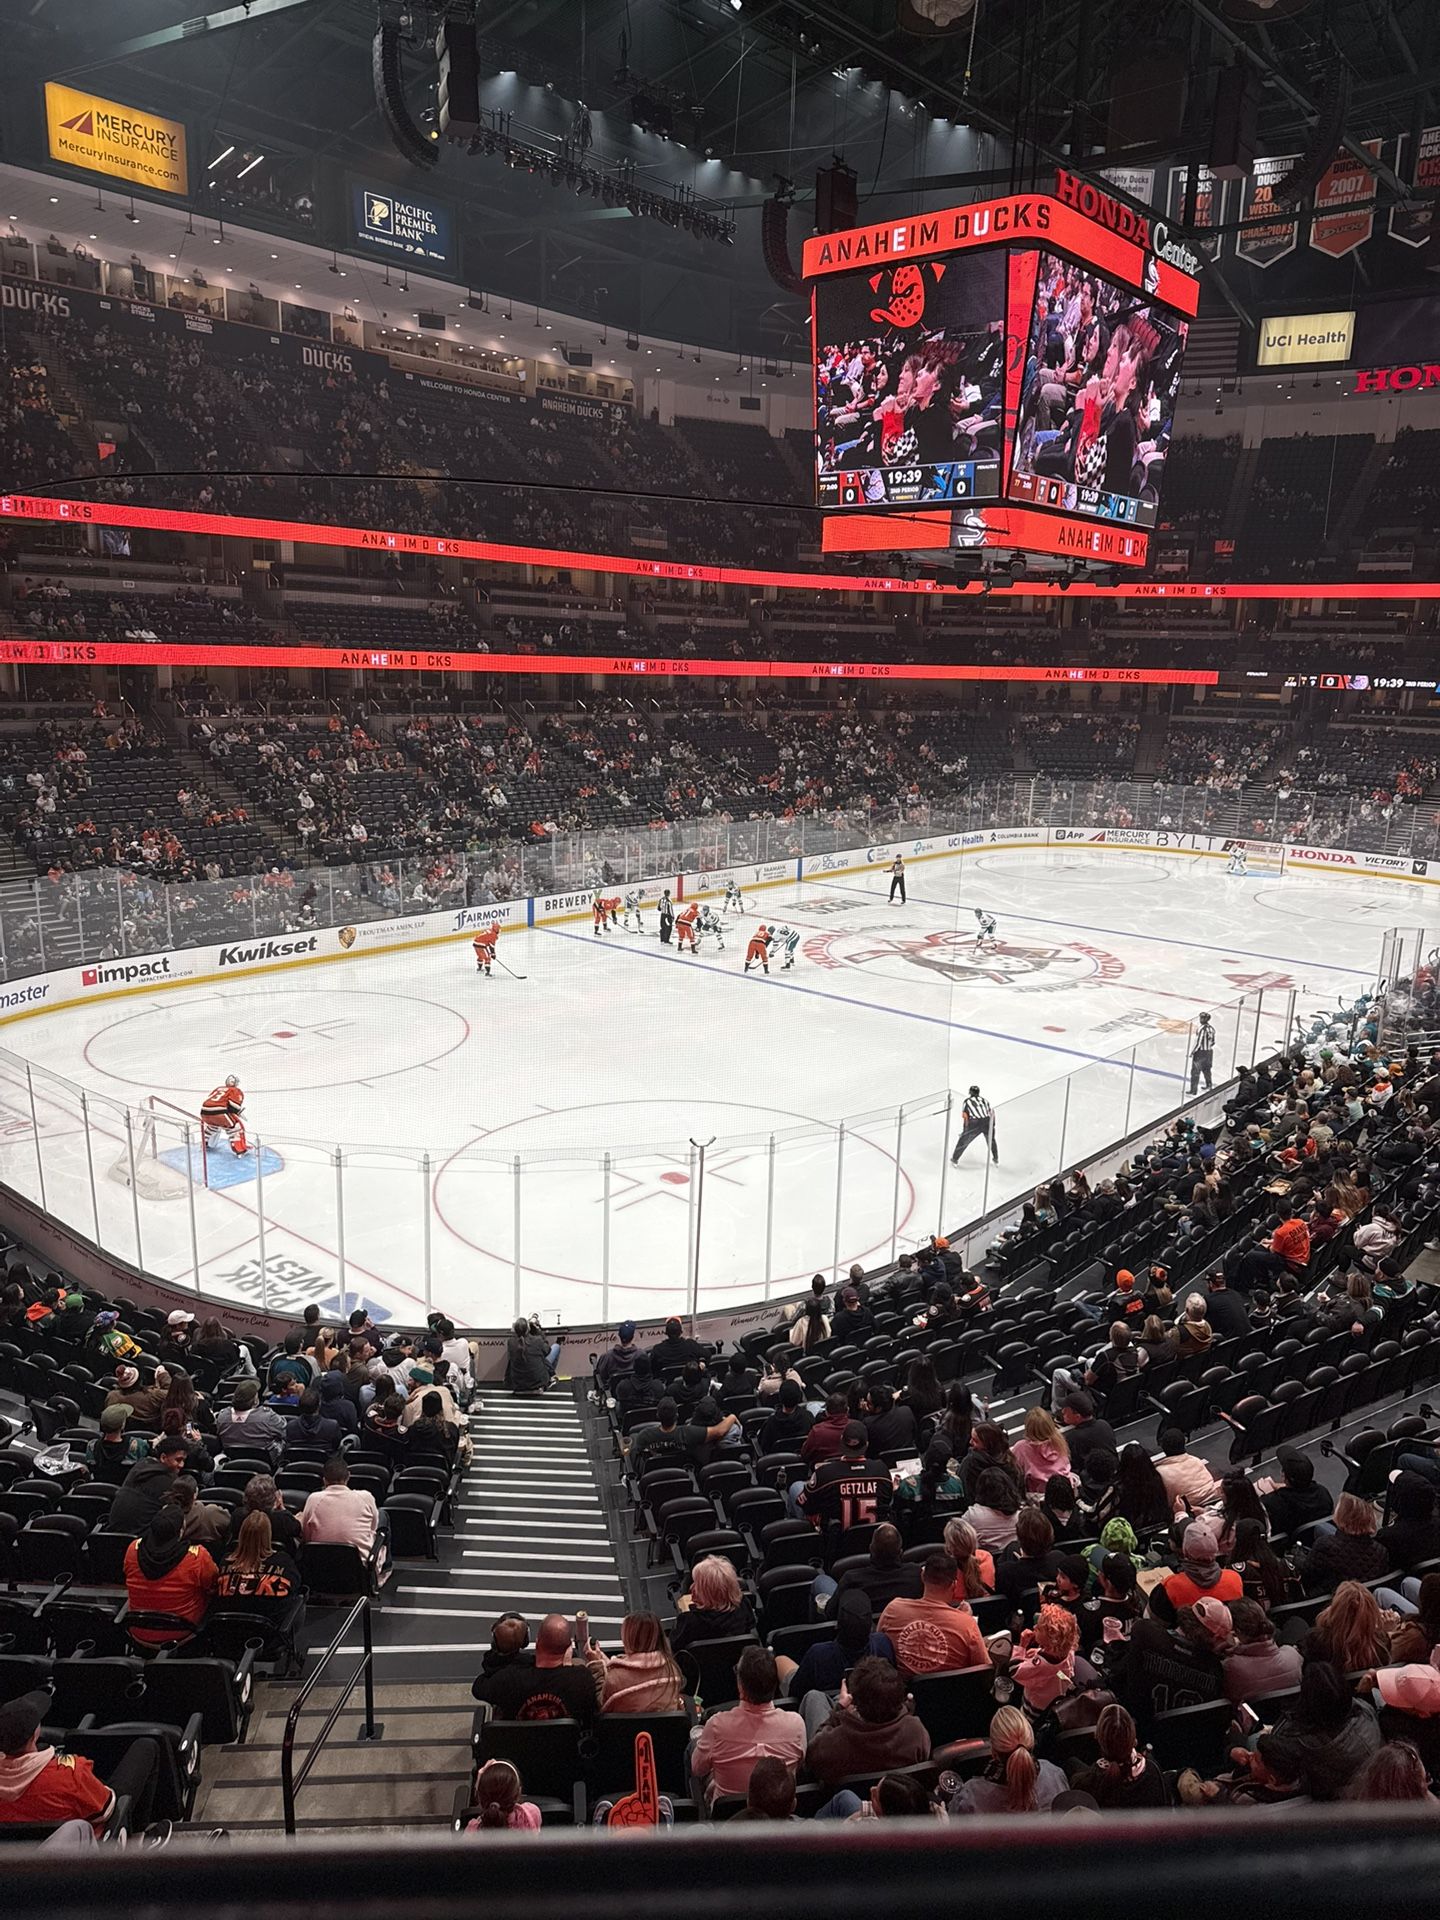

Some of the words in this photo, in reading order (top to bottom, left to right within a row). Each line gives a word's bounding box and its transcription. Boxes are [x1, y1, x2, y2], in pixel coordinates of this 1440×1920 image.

[96, 111, 176, 148] MERCURY
[96, 127, 178, 161] INSURANCE
[58, 137, 179, 181] MercuryInsurance.com
[1253, 159, 1294, 175] ANAHEIM
[1128, 174, 1149, 185] Ducks
[1329, 176, 1364, 195] 2007
[1318, 193, 1352, 208] STANLEY
[1353, 190, 1373, 202] CUP
[394, 201, 433, 222] PACIFIC
[394, 213, 438, 235] PREMIER
[1057, 168, 1151, 250] HONDA
[1153, 222, 1203, 275] Center
[394, 225, 423, 242] BANK
[819, 219, 939, 266] ANAHEIM
[953, 203, 1050, 240] DUCKS
[1241, 223, 1293, 239] CHAMPIONS
[1, 285, 70, 317] DUCKS
[1265, 335, 1292, 347] UCI
[1297, 331, 1347, 346] Health
[302, 346, 352, 373] DUCKS
[420, 379, 452, 392] WELCOME
[463, 388, 485, 399] HONDA
[486, 393, 511, 404] CENTER
[542, 398, 576, 414] ANAHEIM
[577, 404, 603, 419] DUCKS
[888, 470, 922, 485] 19:39
[845, 489, 855, 501] 0
[956, 481, 966, 494] 0
[1050, 486, 1057, 500] 0
[1080, 489, 1099, 503] 19:39
[1119, 501, 1126, 514] 0
[362, 533, 417, 549] ANAHIM
[423, 540, 459, 553] DCKS
[1058, 526, 1114, 553] ANAHEIM
[1118, 537, 1147, 559] DUCK
[636, 563, 674, 575] ANAHIM
[678, 566, 703, 577] DCKS
[1135, 586, 1185, 595] ANAHIM
[1190, 586, 1227, 595] DCKS
[341, 652, 404, 666] ANAHEIM
[411, 655, 452, 667] DCKS
[613, 660, 656, 672] ANAHEIM
[660, 662, 689, 673] DCKS
[812, 664, 855, 675] ANAHEIM
[859, 665, 890, 676] DCKS
[1045, 669, 1098, 679] ANAHEIM
[1103, 670, 1141, 680] DCKS
[1326, 677, 1335, 686] 0
[1373, 678, 1404, 688] 19:39
[948, 838, 961, 847] UCI
[961, 835, 984, 846] Health
[997, 832, 1022, 840] COLUMBIA
[1023, 831, 1039, 839] BANK
[1107, 829, 1151, 839] MERCURY
[1107, 836, 1151, 845] INSURANCE
[1156, 832, 1217, 851] BYLT
[1290, 848, 1357, 865] HONDA
[822, 859, 849, 872] SOLAR
[545, 893, 593, 911] BREWERY
[457, 908, 511, 927] FAIRMONT
[218, 936, 318, 966] Kwikset
[98, 957, 171, 984] impact
[840, 1482, 878, 1495] GETZLAF
[840, 1497, 878, 1530] 15
[526, 1692, 562, 1706] ANAHEIM
[641, 1765, 651, 1804] FAN
